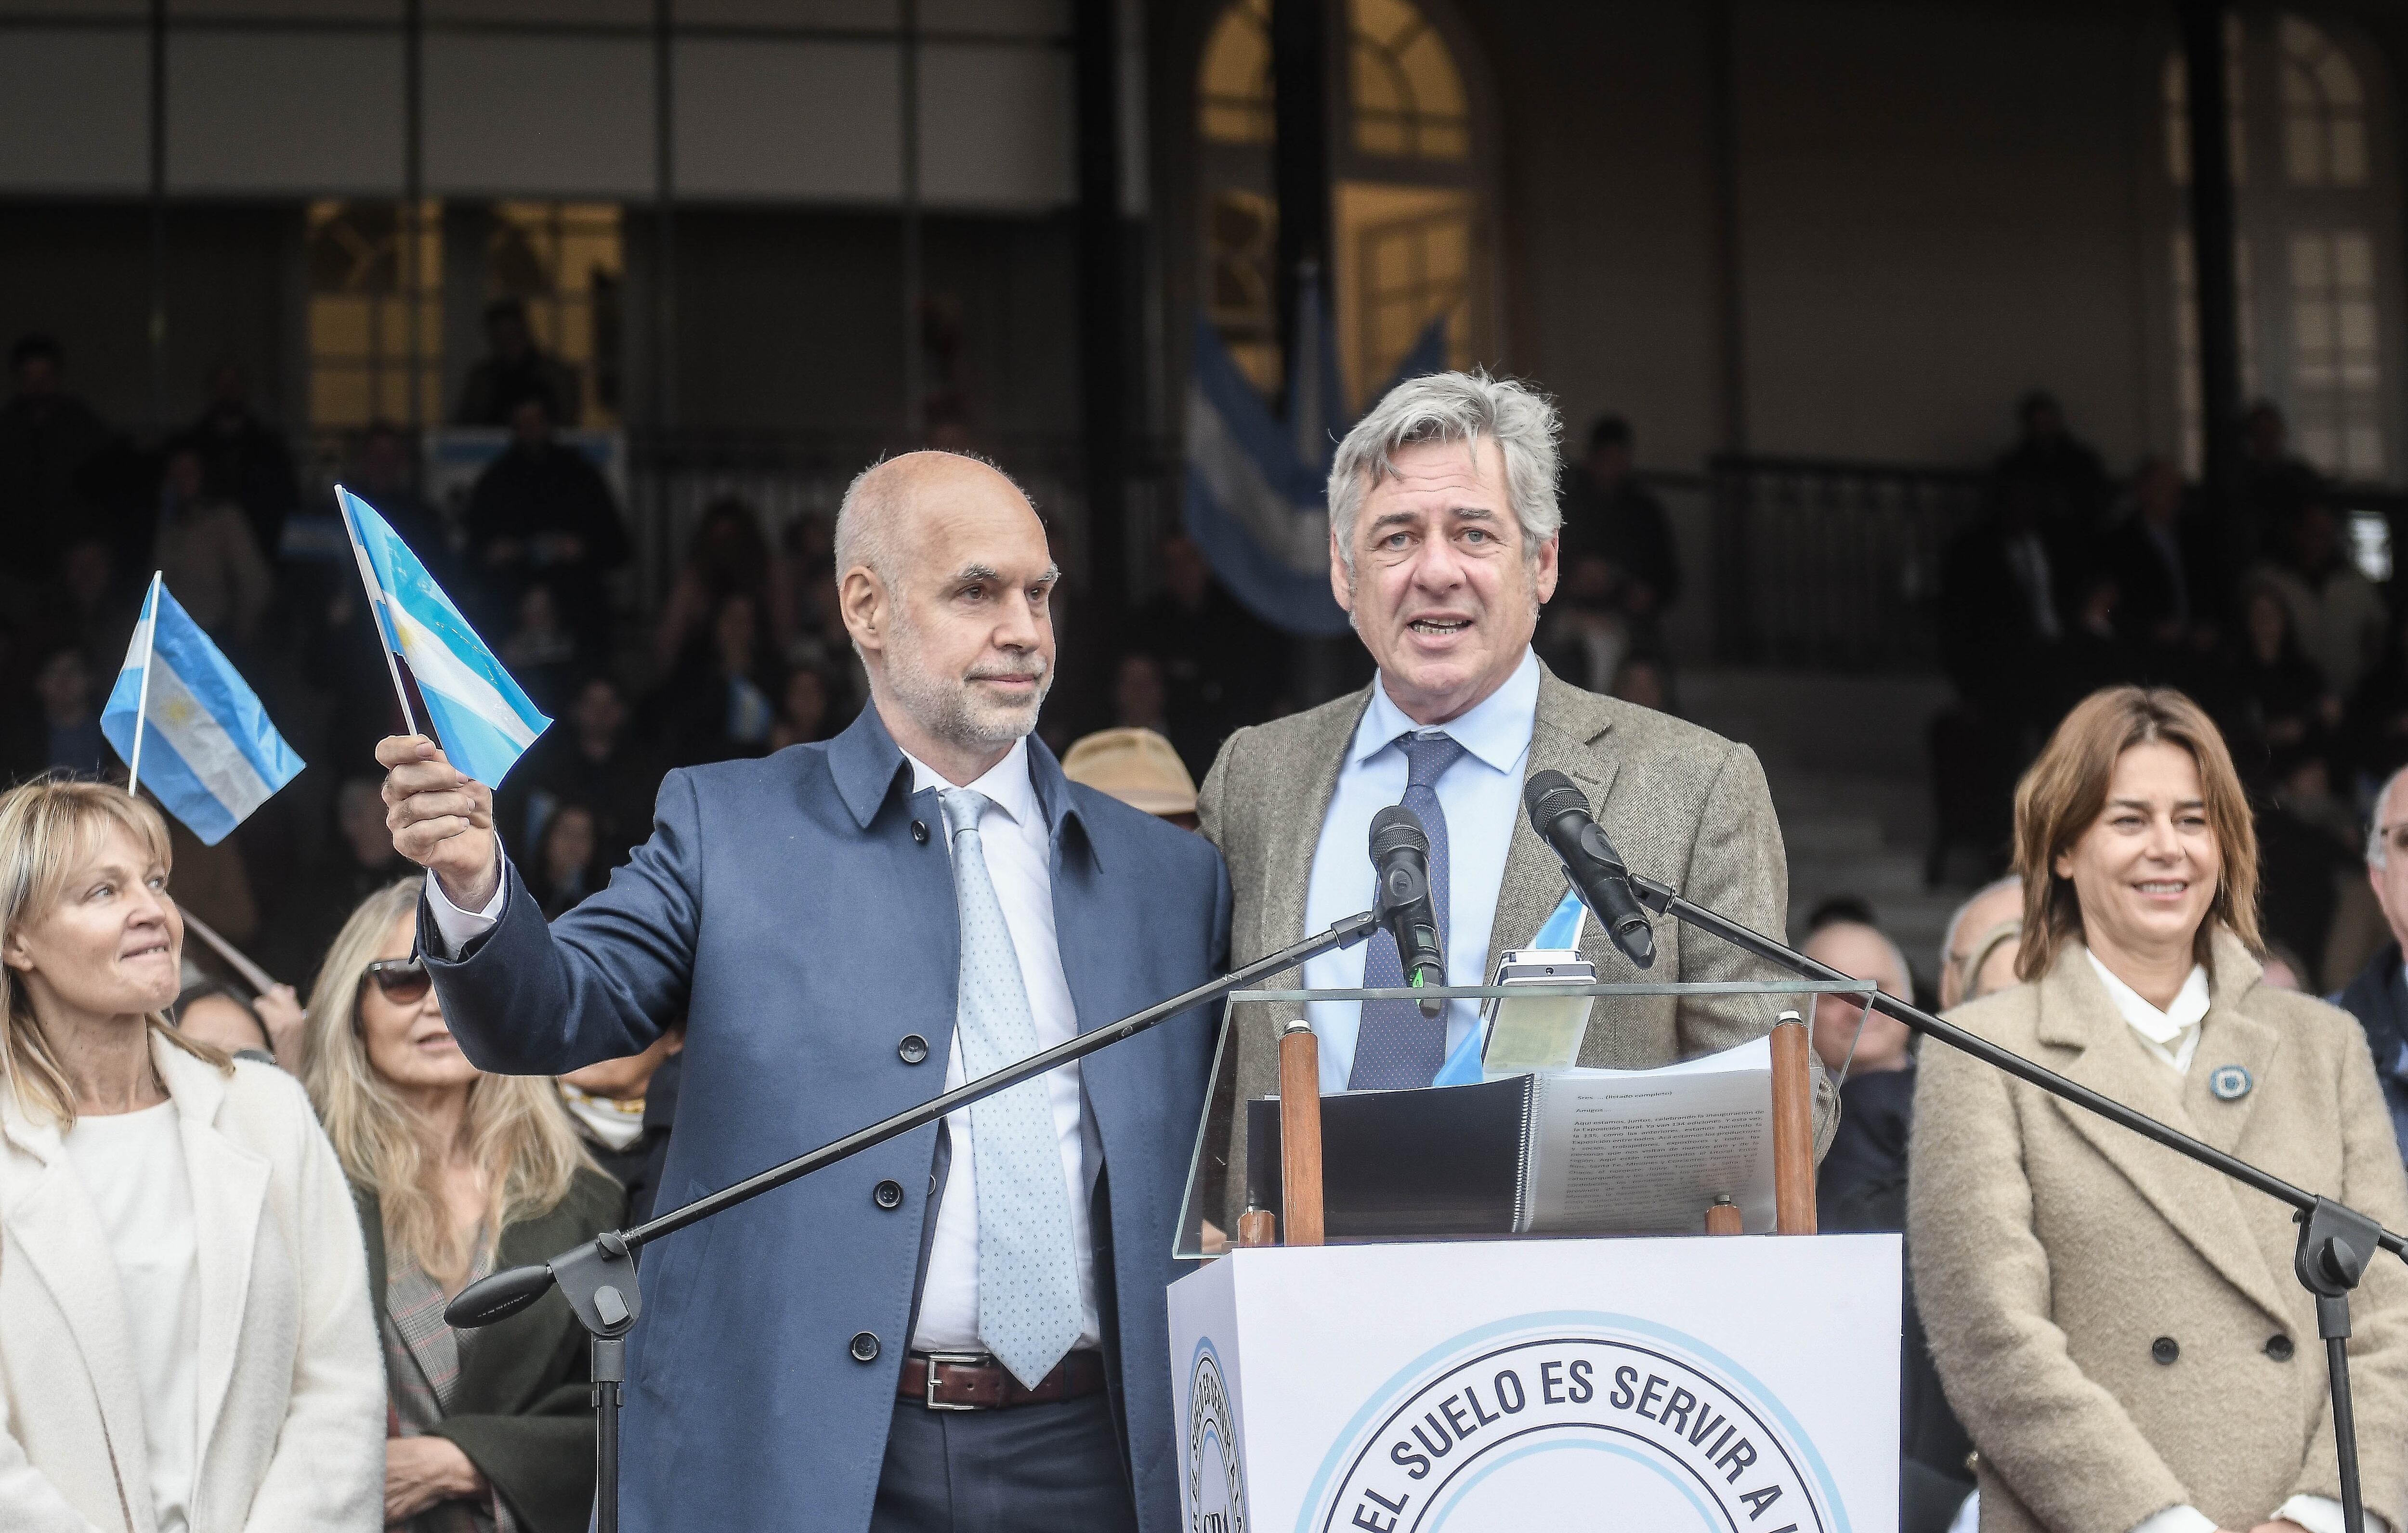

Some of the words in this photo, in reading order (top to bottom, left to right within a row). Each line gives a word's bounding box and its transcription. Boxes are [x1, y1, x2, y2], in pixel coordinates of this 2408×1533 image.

[1203, 1372, 1211, 1405] ES
[1192, 1381, 1204, 1462] SUELO
[1210, 1375, 1231, 1462] SERVIR
[1352, 1488, 1410, 1533] EL
[1390, 1370, 1526, 1480] SUELO
[1541, 1360, 1593, 1405] ES
[1610, 1365, 1758, 1485] SERVIR
[1739, 1484, 1783, 1522] A
[1191, 1468, 1198, 1503] EL
[1230, 1462, 1236, 1489] A
